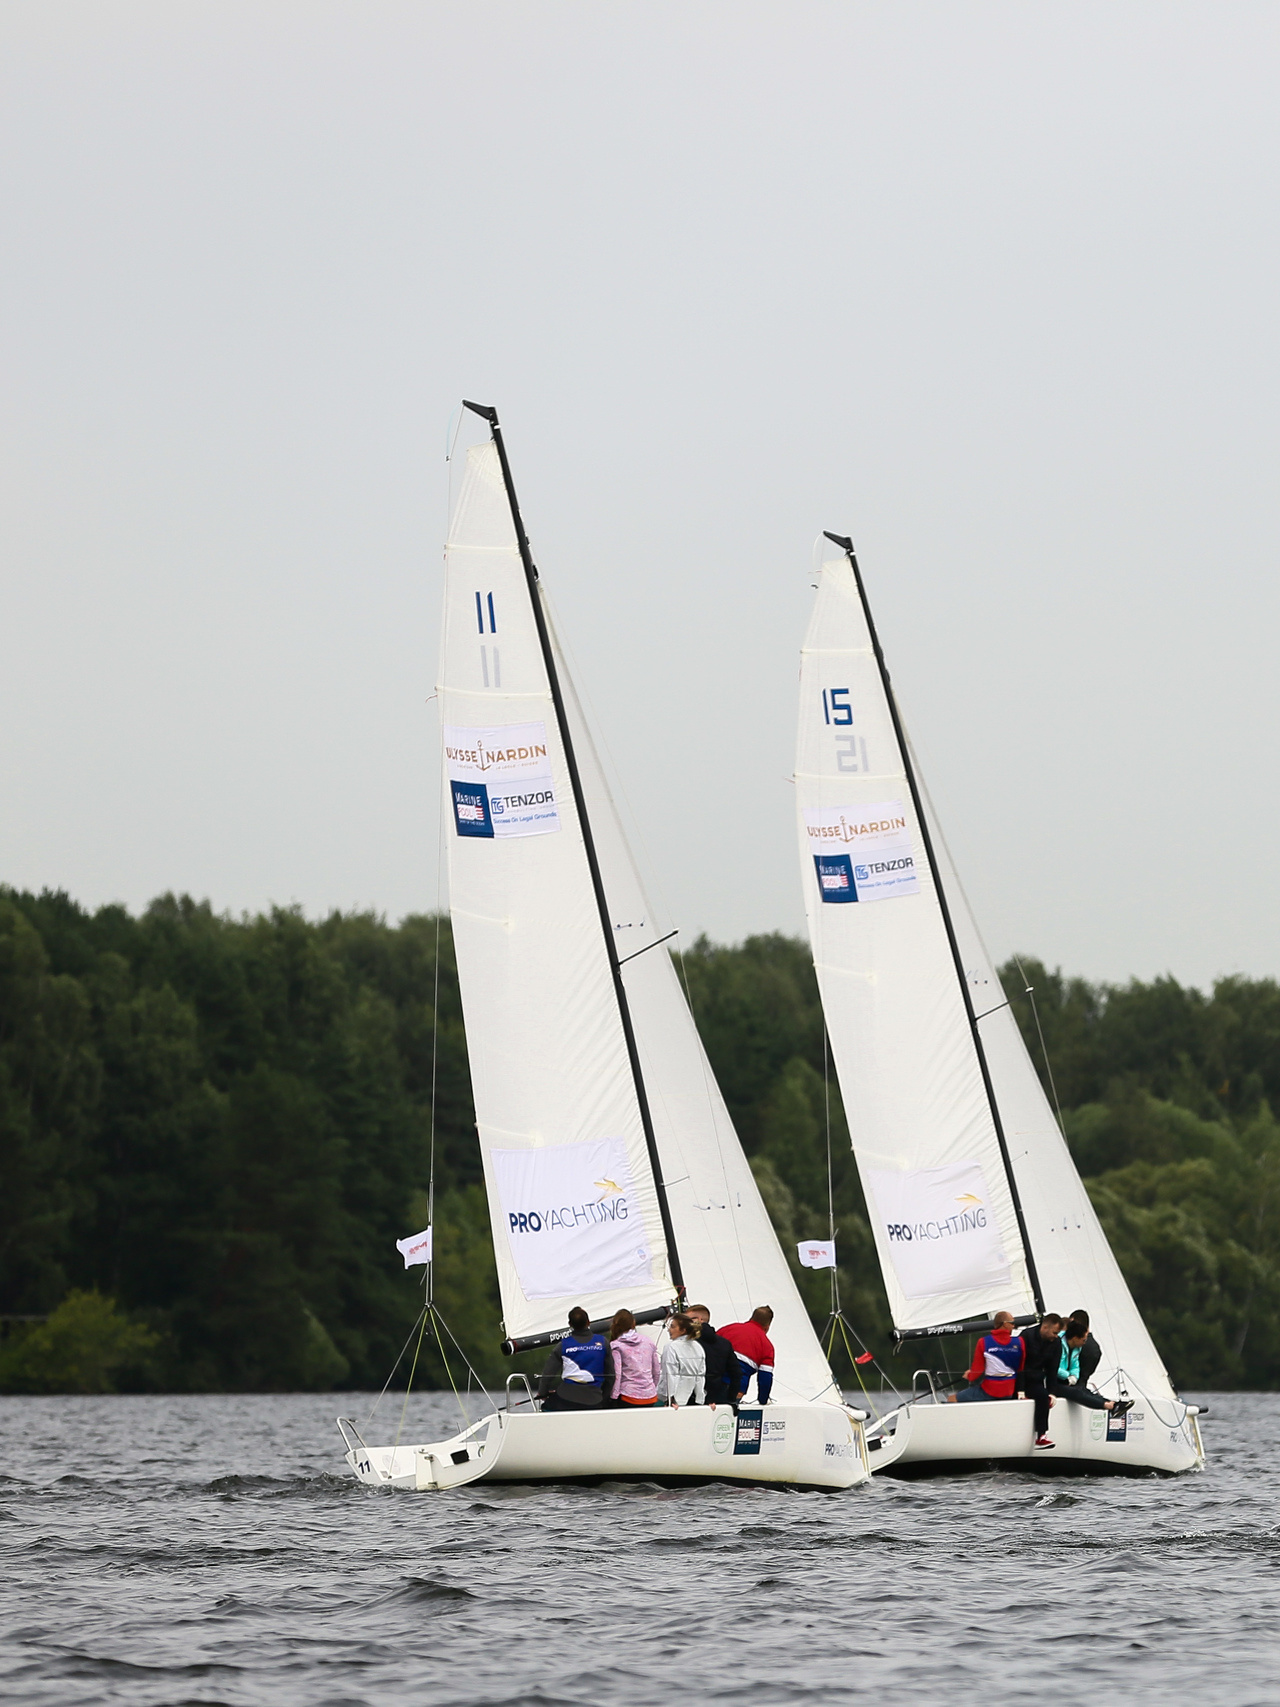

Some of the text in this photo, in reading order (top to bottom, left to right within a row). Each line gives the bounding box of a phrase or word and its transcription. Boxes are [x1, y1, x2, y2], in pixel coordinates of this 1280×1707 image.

[475, 591, 497, 634] 11
[822, 688, 853, 725] 15
[486, 744, 547, 763] NARDIN
[455, 791, 482, 806] MARINE
[503, 790, 554, 808] TENZOR
[458, 806, 474, 818] POOL
[849, 816, 906, 836] NARDIN
[868, 857, 914, 874] TENZOR
[509, 1198, 628, 1233] PROYACHTING
[887, 1208, 987, 1241] PROYACHTING
[739, 1419, 760, 1428] MARINE
[358, 1460, 371, 1474] 11
